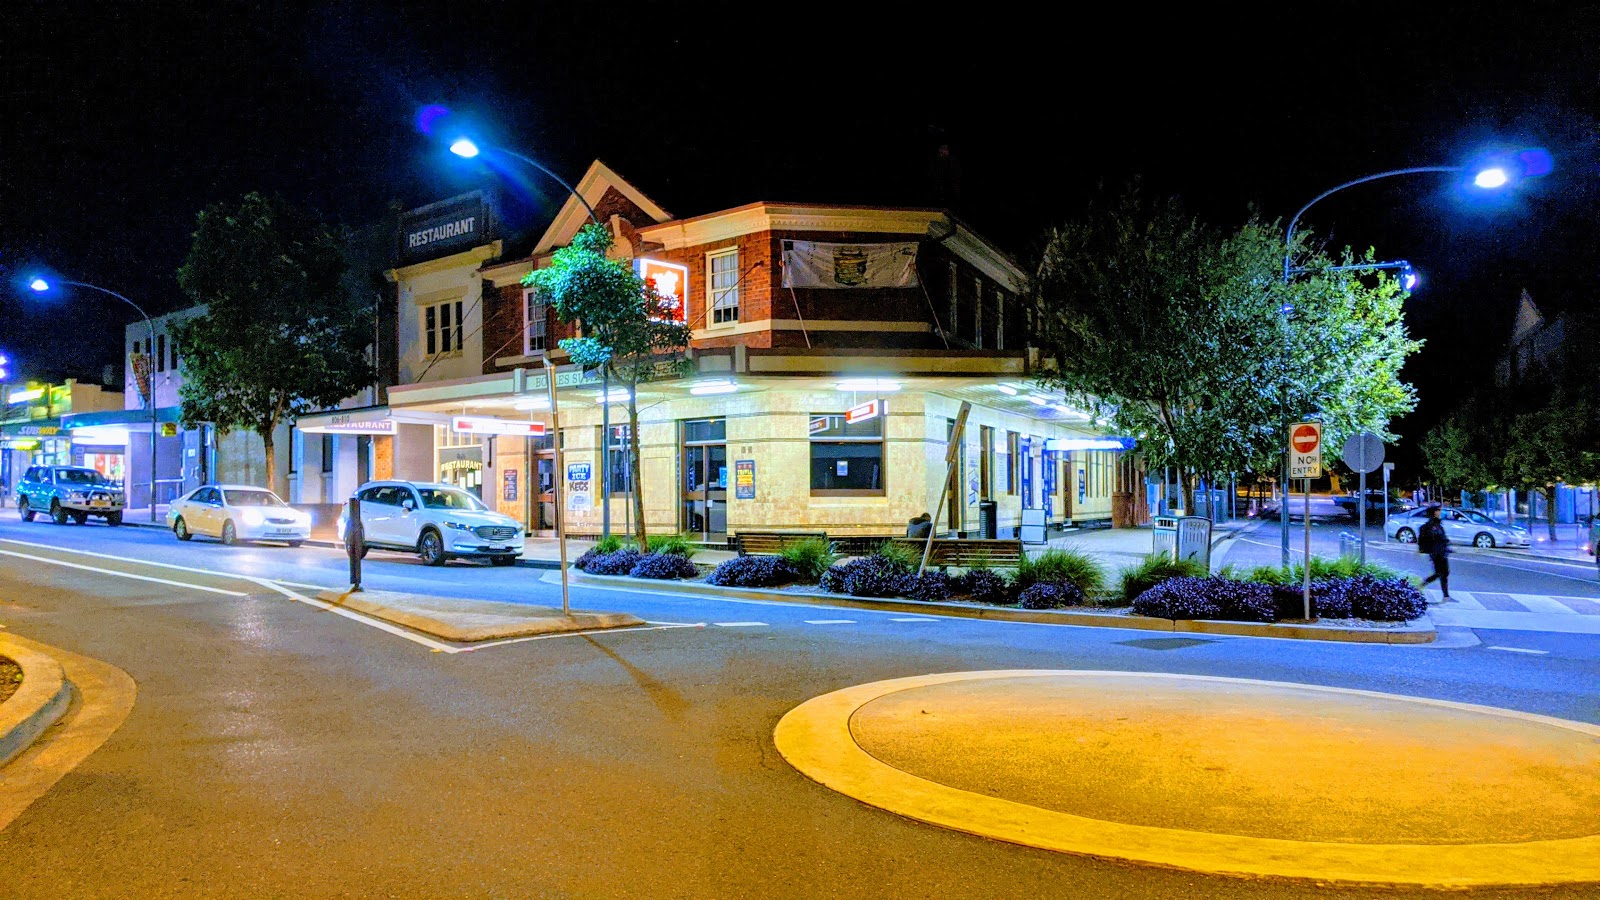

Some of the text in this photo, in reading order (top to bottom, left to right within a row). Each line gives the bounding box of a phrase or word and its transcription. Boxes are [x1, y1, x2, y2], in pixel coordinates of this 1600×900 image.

[409, 217, 475, 248] RESTAURANT
[18, 426, 59, 435] SUBWAY
[441, 460, 482, 471] RESTAURANT
[569, 464, 590, 473] PARTY
[1292, 466, 1318, 475] ENTRY
[569, 481, 589, 492] KEGS
